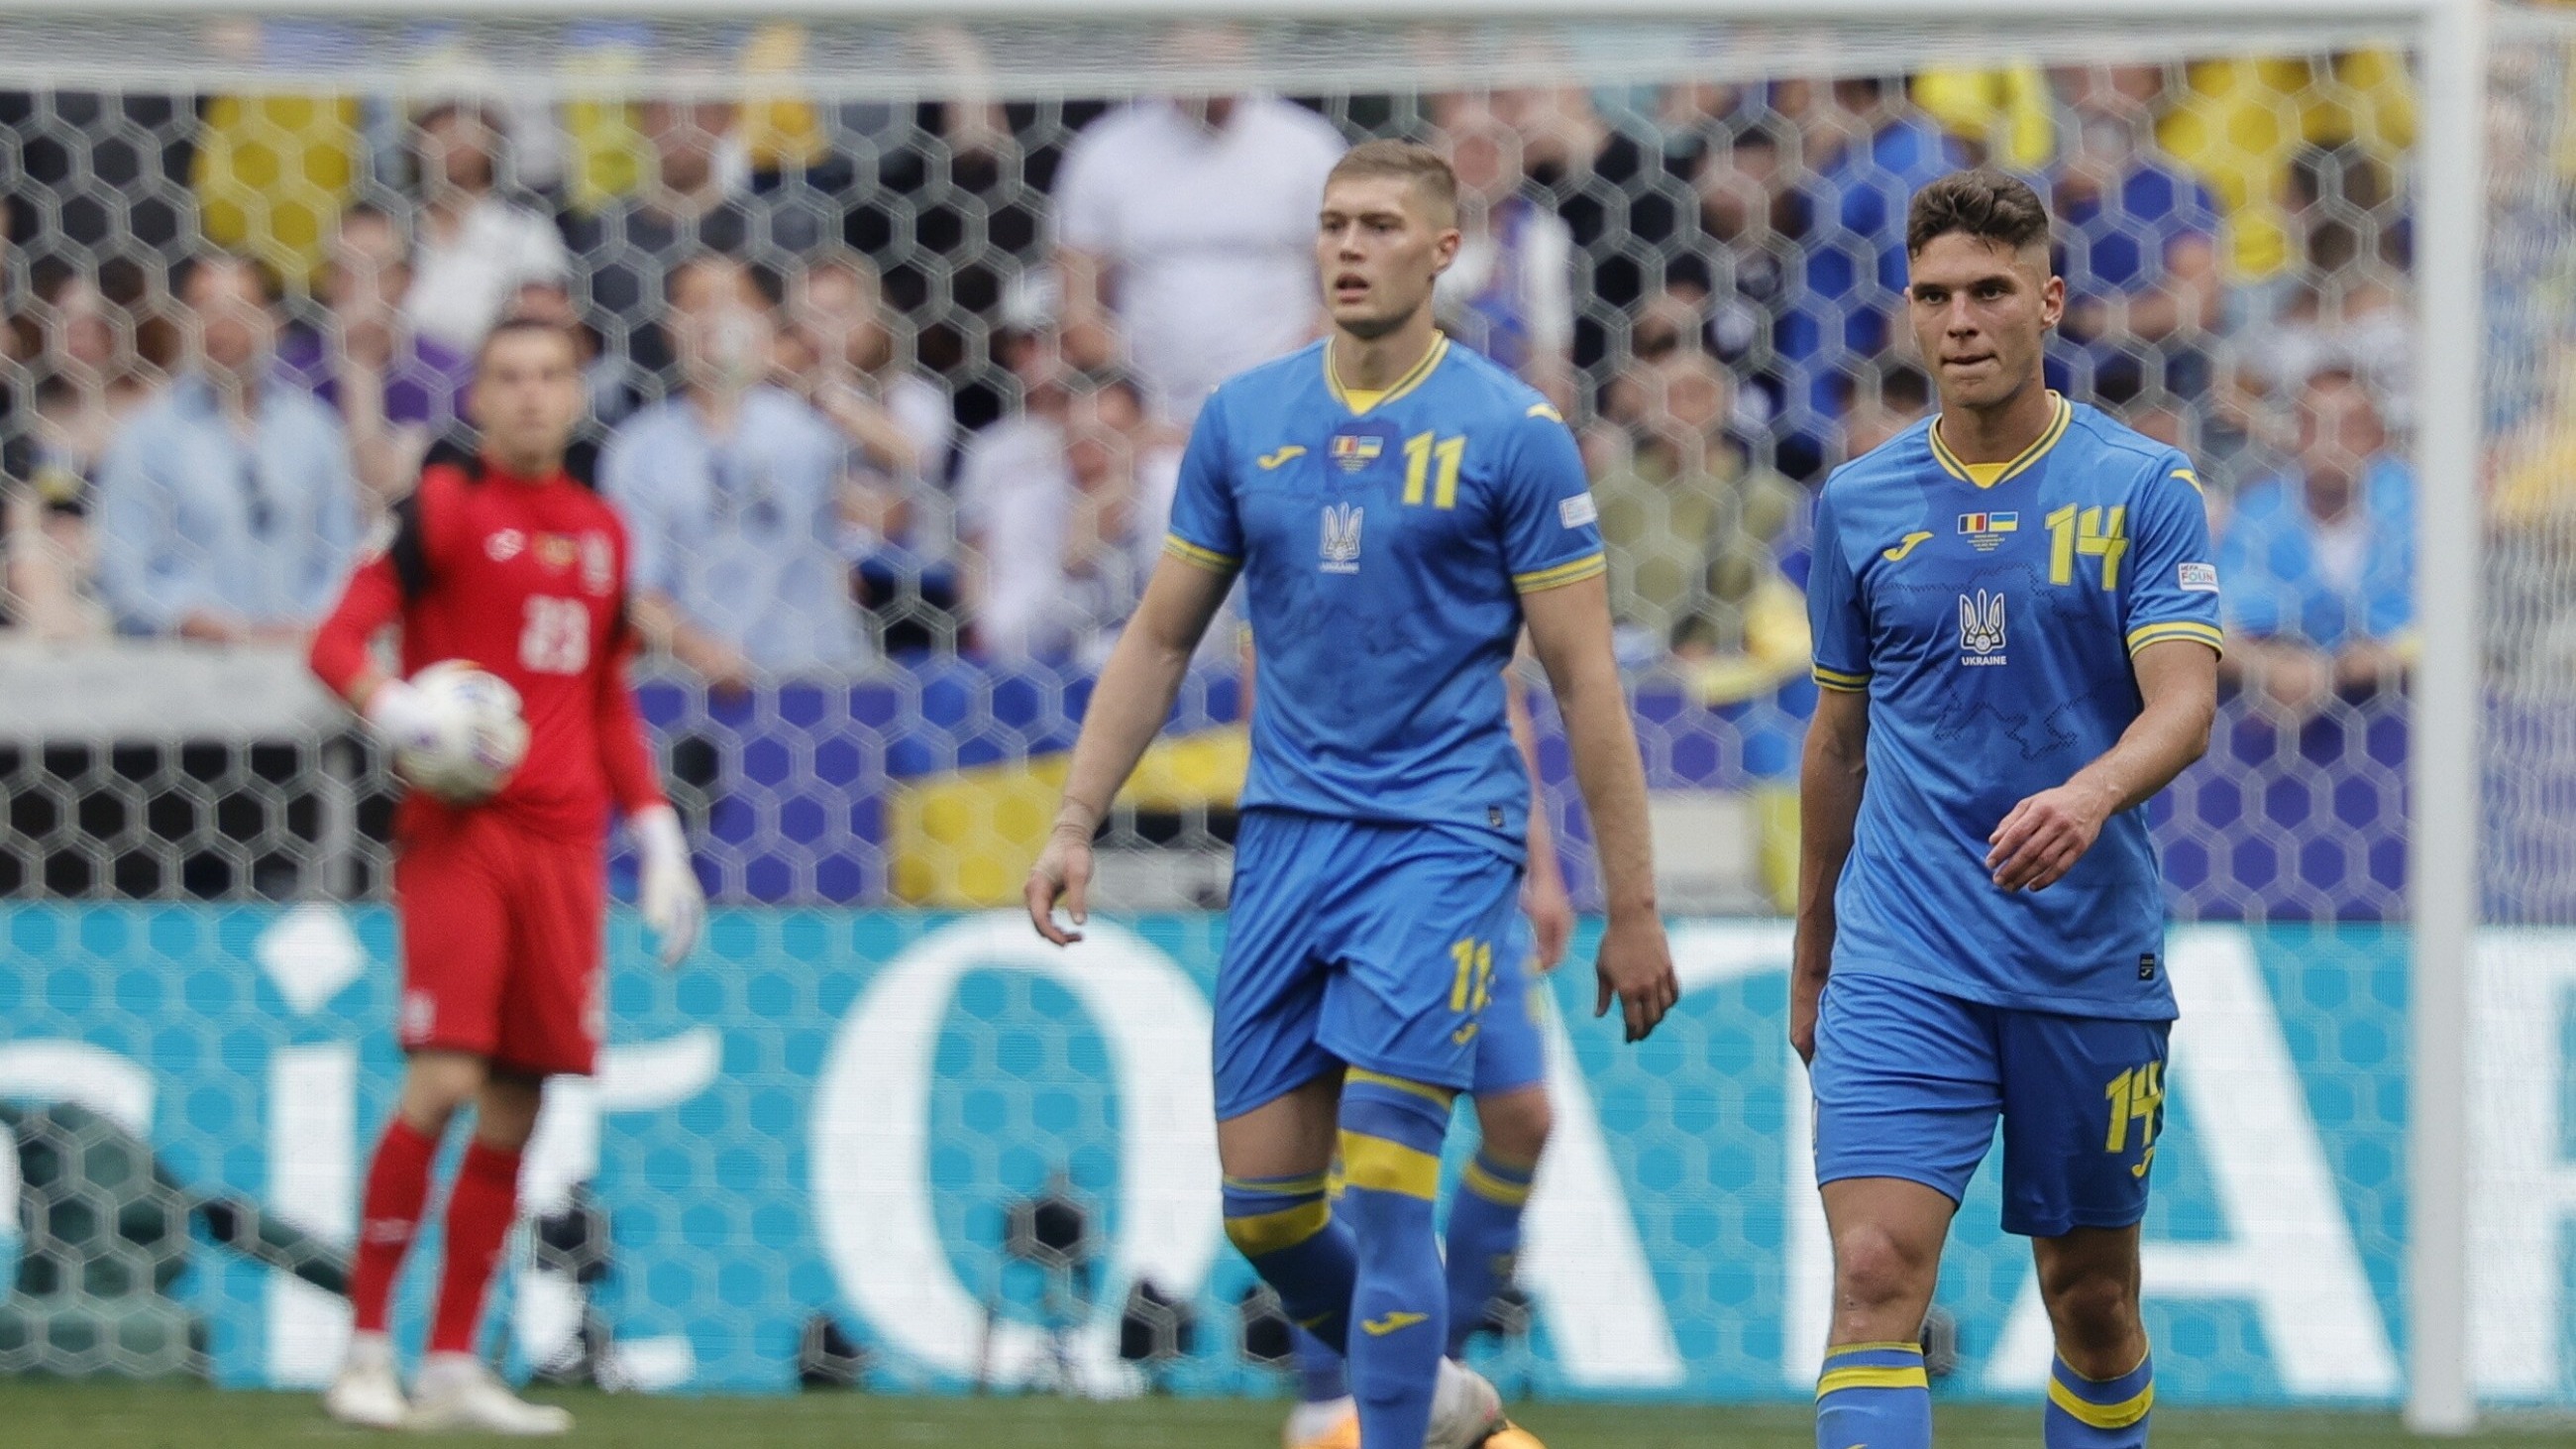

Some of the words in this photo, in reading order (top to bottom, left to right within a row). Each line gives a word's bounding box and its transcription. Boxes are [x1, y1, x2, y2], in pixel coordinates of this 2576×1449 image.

[1402, 430, 1466, 508] 11
[2045, 502, 2129, 590] 14
[1962, 655, 2007, 666] UKRAINE
[2104, 1059, 2164, 1154] 14
